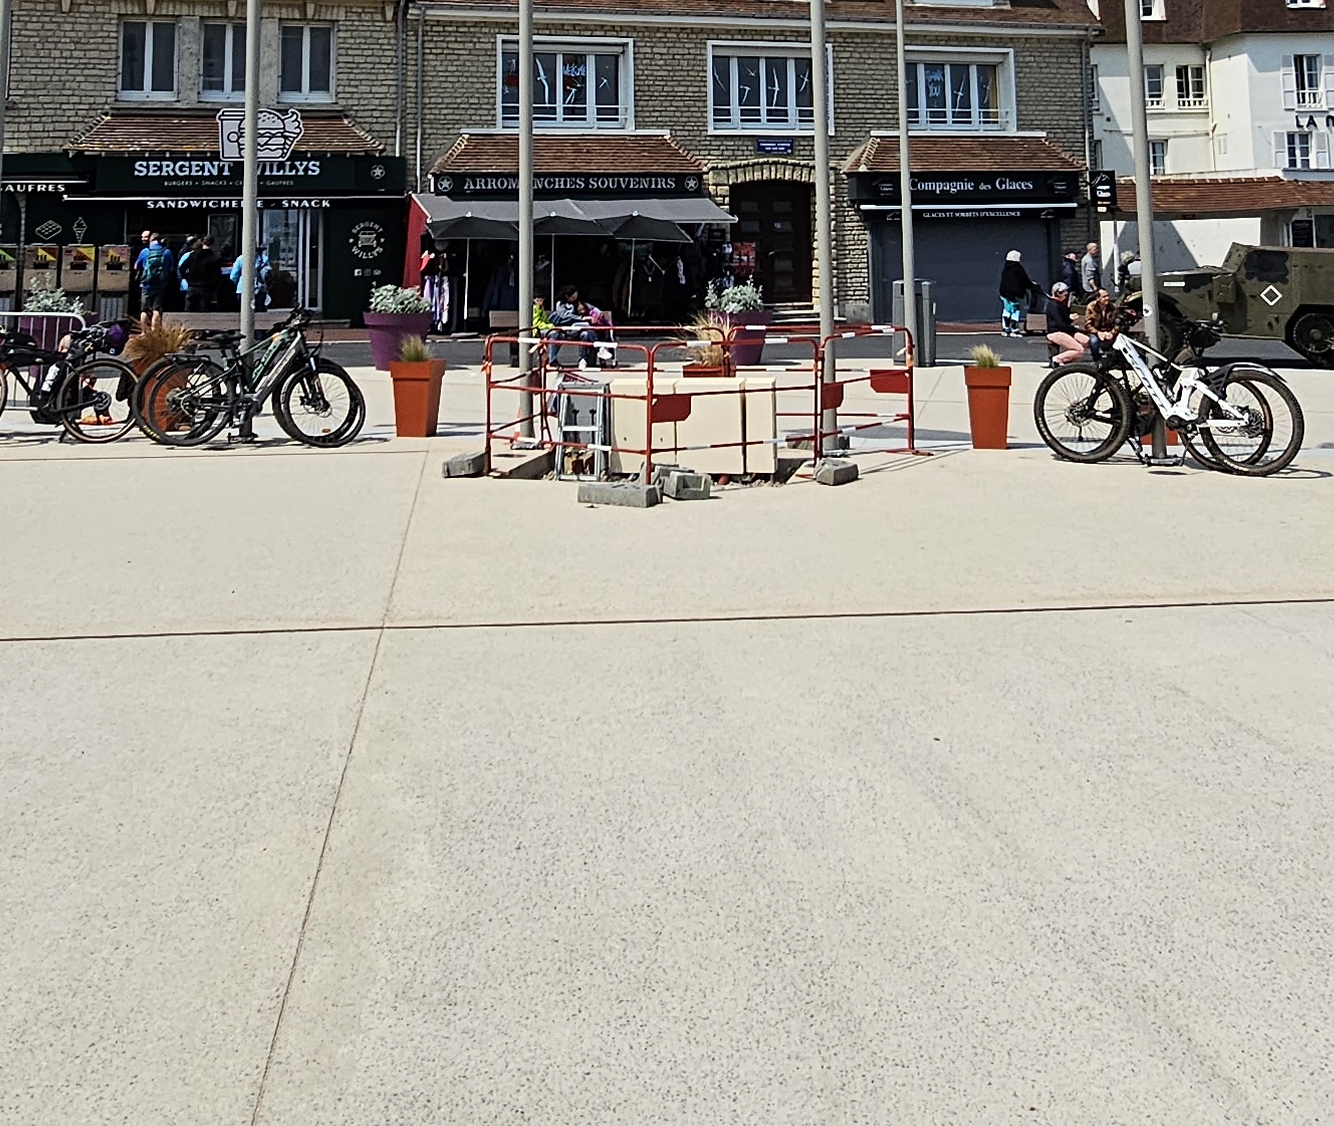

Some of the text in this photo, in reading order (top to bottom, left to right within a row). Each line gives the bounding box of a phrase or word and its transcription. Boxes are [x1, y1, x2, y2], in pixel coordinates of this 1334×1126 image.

[1296, 114, 1317, 128] LA
[134, 161, 234, 176] SERGENT
[0, 184, 66, 193] AUFRES
[464, 177, 676, 189] ARROMNCHES SOUVENIRS
[908, 178, 974, 194] Compagnie
[978, 182, 992, 191] des
[995, 177, 1033, 191] Glaces
[281, 200, 331, 208] SNACK
